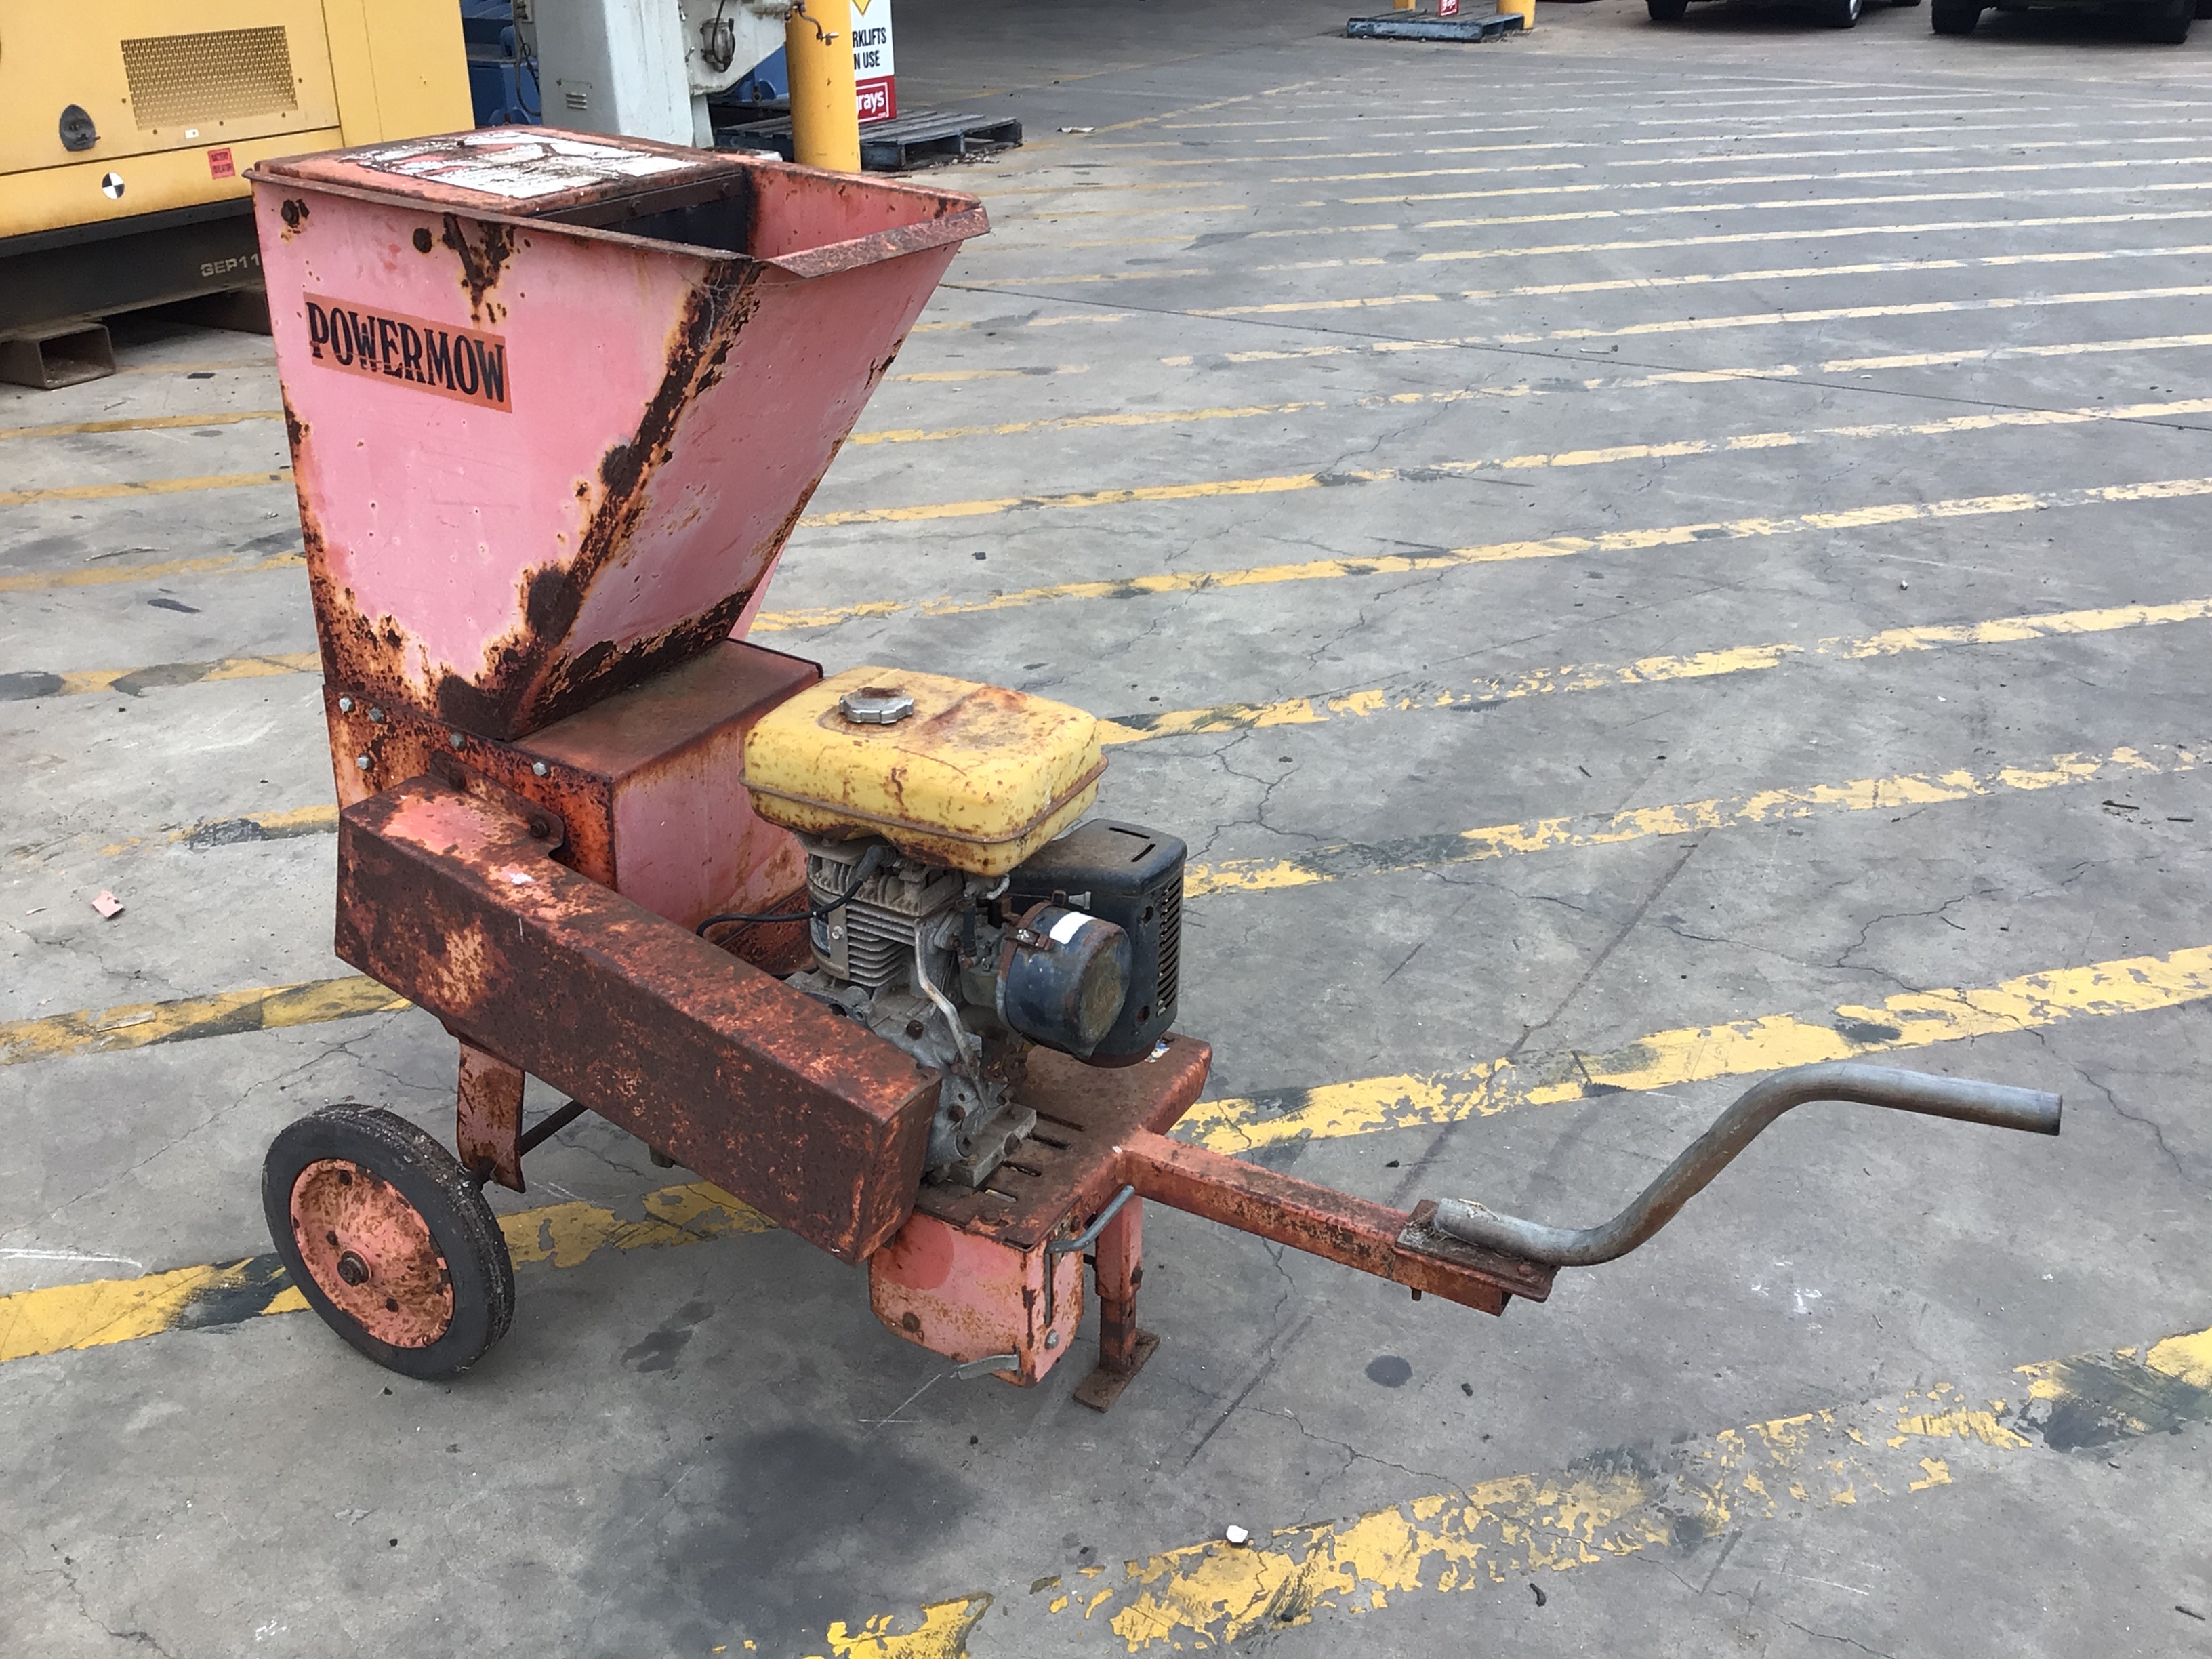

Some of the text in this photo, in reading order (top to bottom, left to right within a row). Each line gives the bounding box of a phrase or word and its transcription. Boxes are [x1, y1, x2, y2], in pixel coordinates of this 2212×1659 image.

[863, 50, 880, 68] USE
[200, 253, 260, 276] GEP11
[306, 302, 505, 402] POWERMOW
